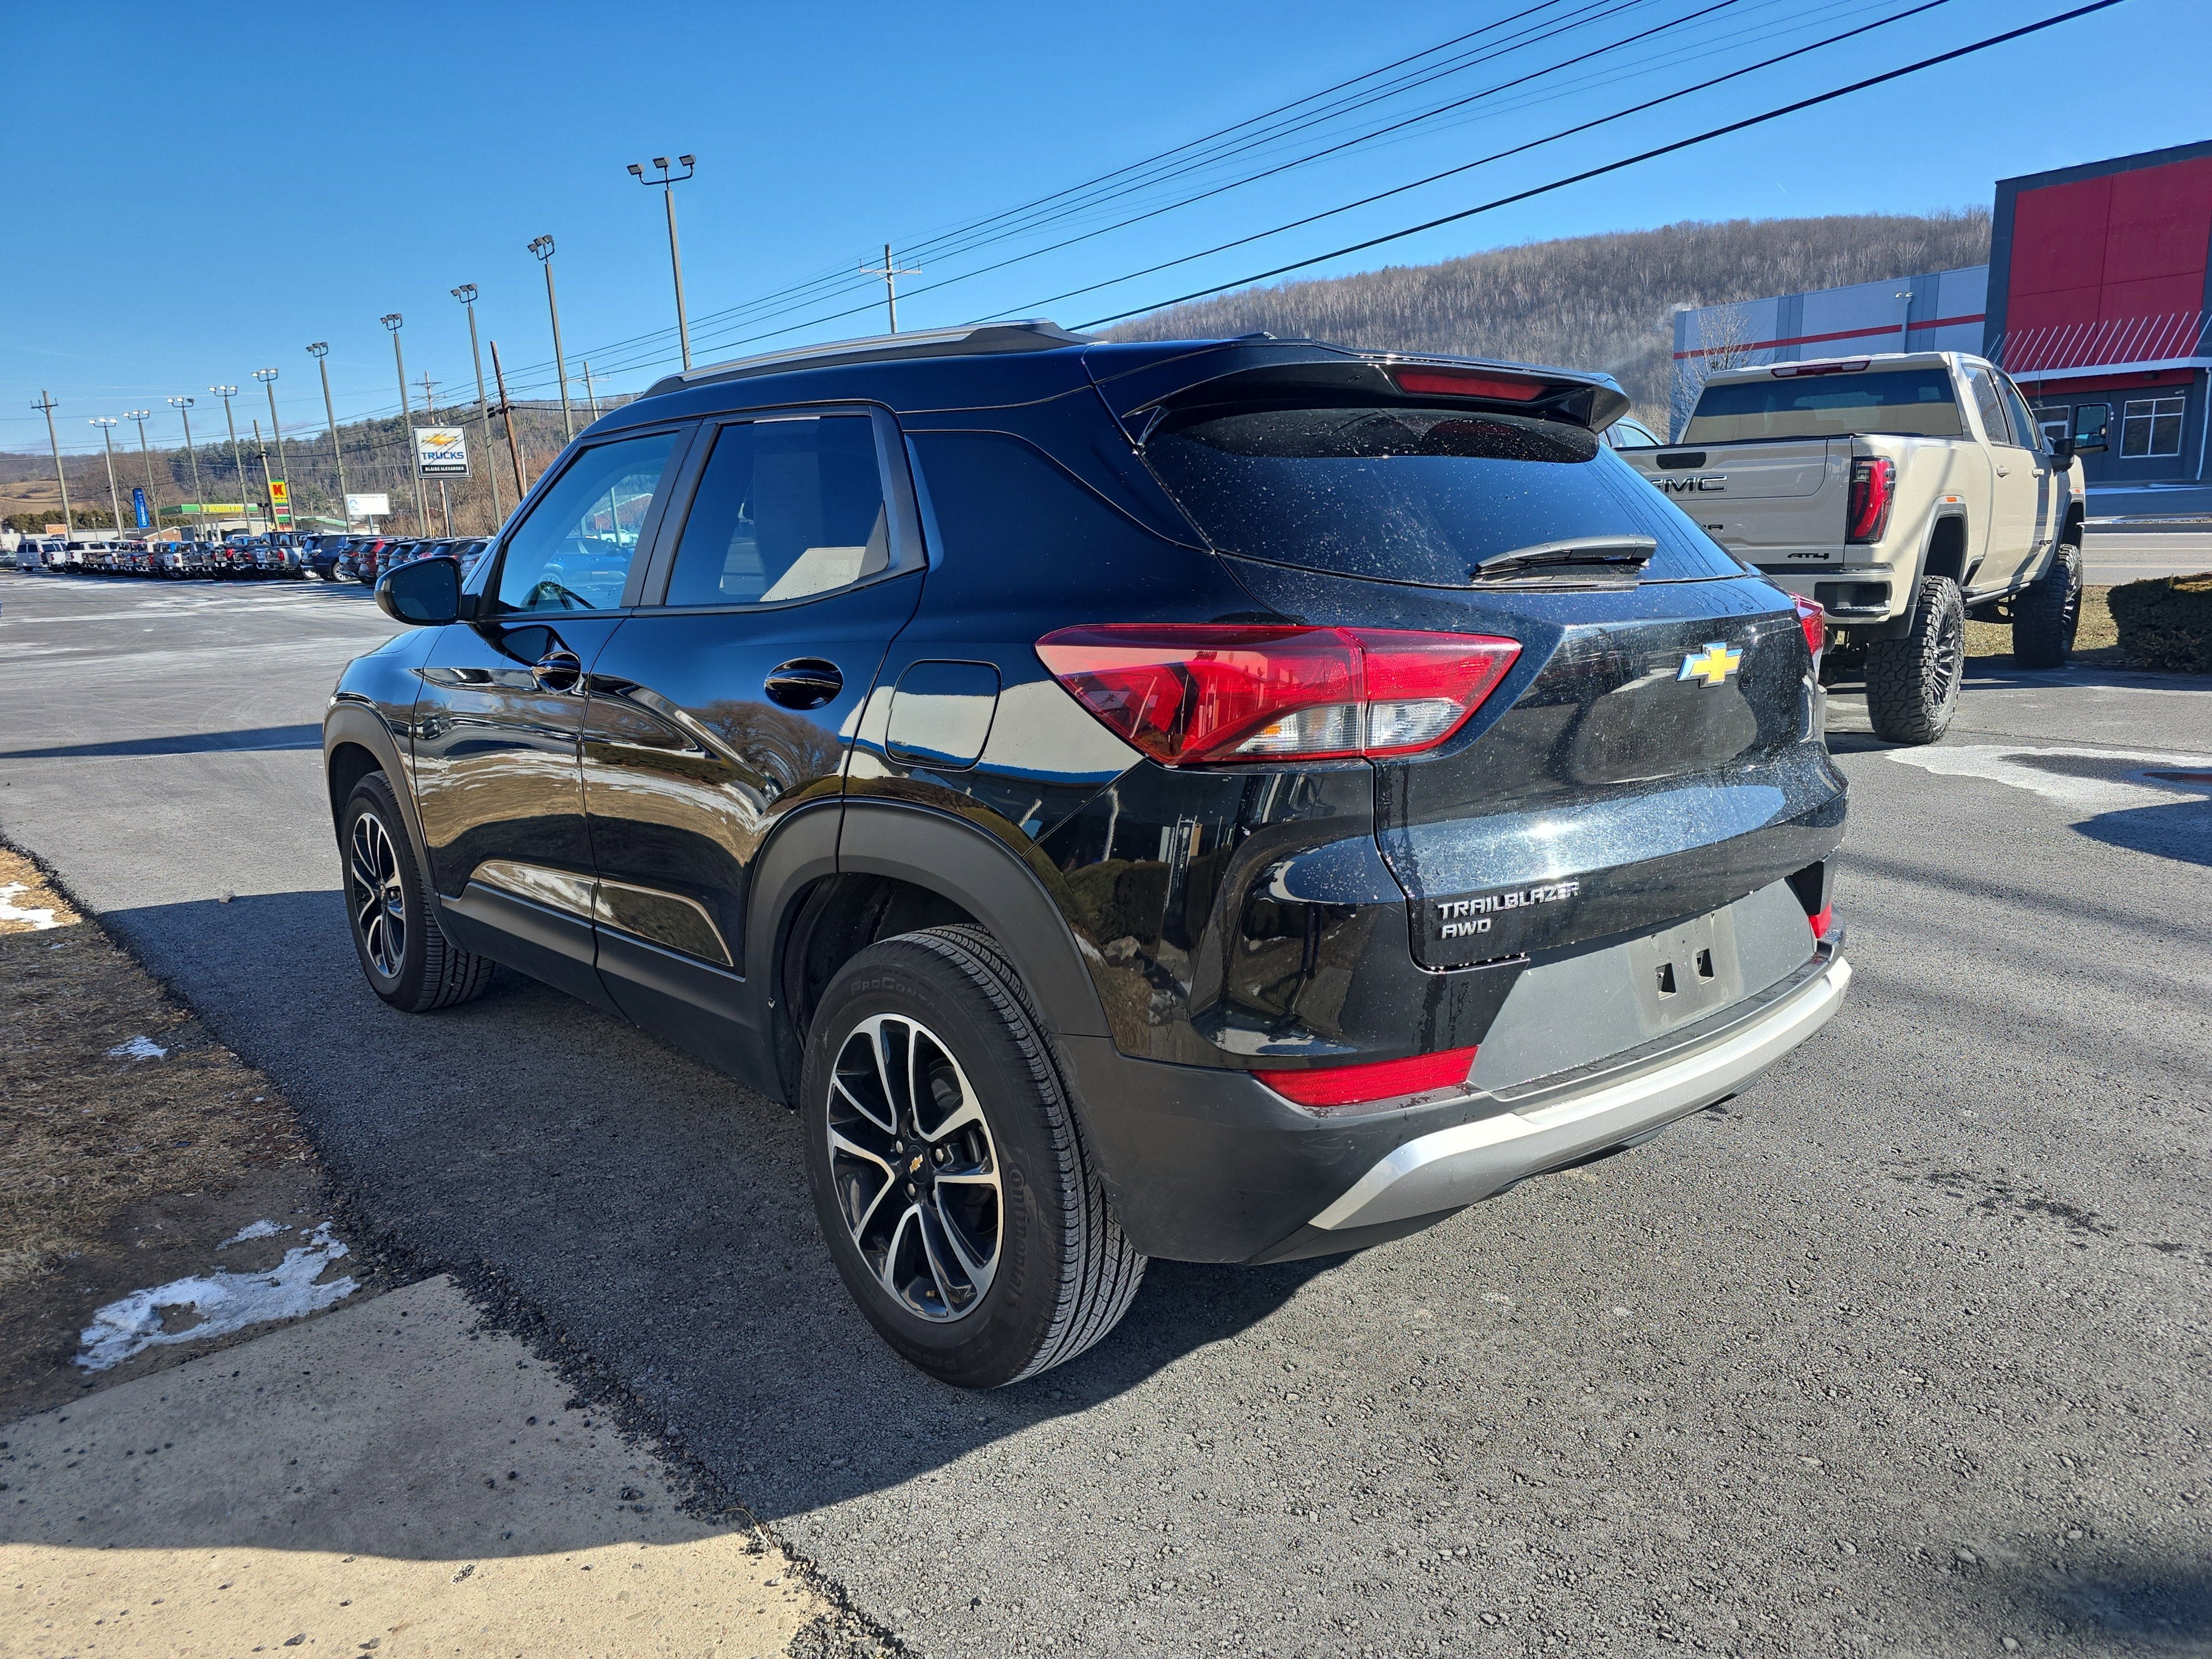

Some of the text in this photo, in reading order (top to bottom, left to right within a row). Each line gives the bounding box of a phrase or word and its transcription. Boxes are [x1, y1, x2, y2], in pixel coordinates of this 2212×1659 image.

[273, 484, 285, 496] K
[1438, 882, 1579, 919] TRAILBLAZER
[1442, 918, 1491, 939] AWD
